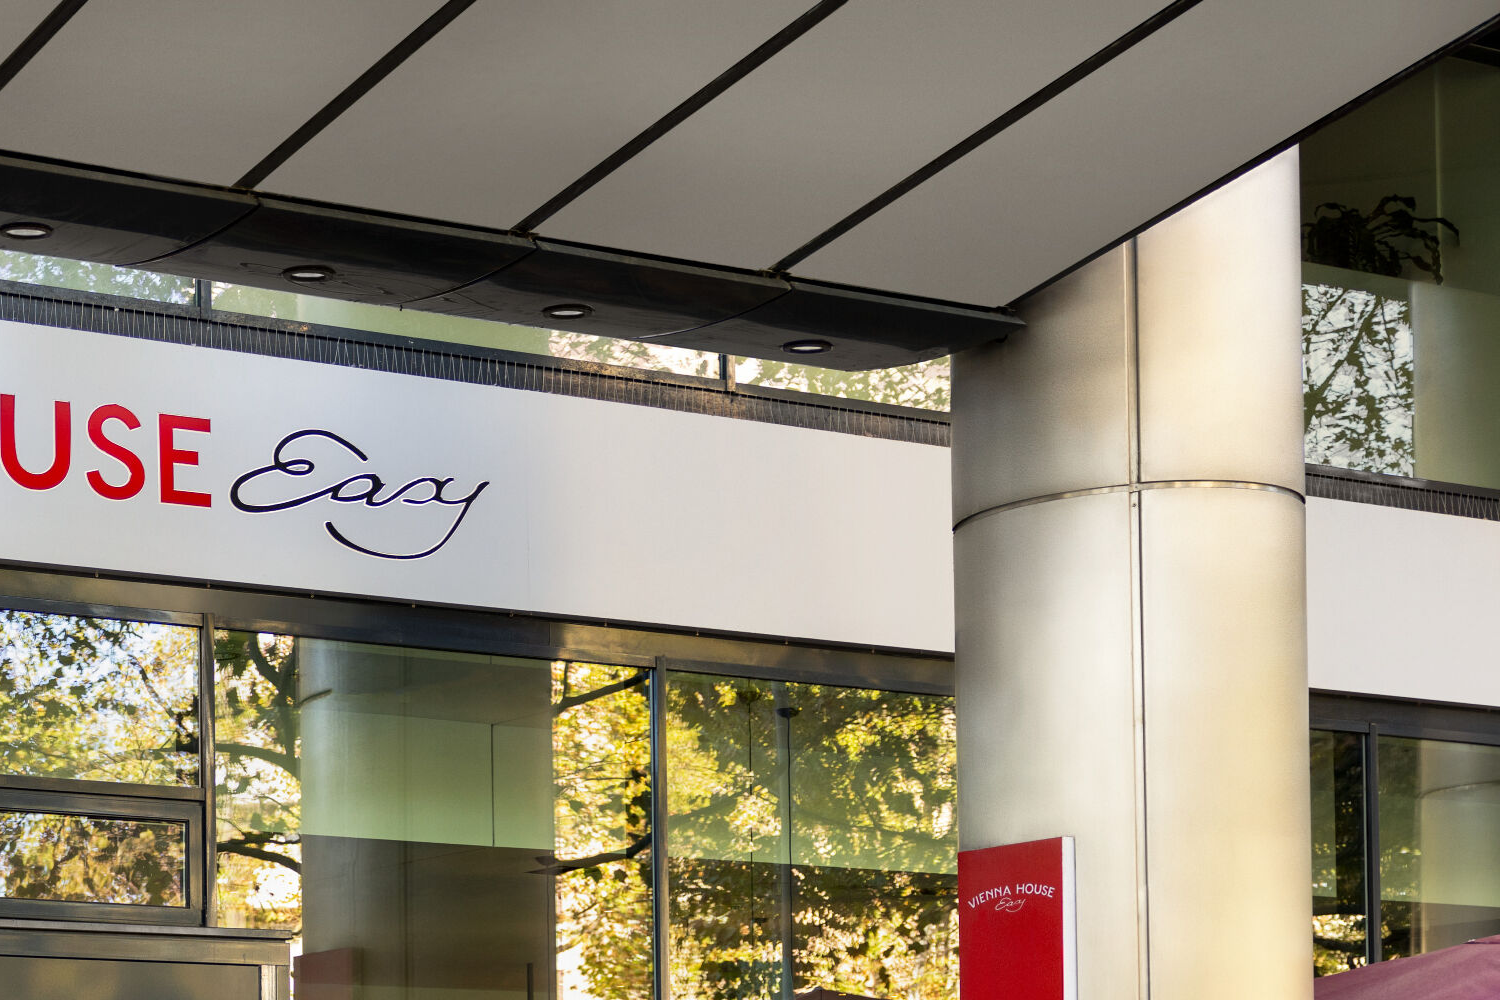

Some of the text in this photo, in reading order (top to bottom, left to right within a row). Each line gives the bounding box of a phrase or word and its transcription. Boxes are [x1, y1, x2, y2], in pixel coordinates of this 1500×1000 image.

[230, 429, 490, 560] Easy
[967, 883, 1055, 909] VIENNA HOUSE
